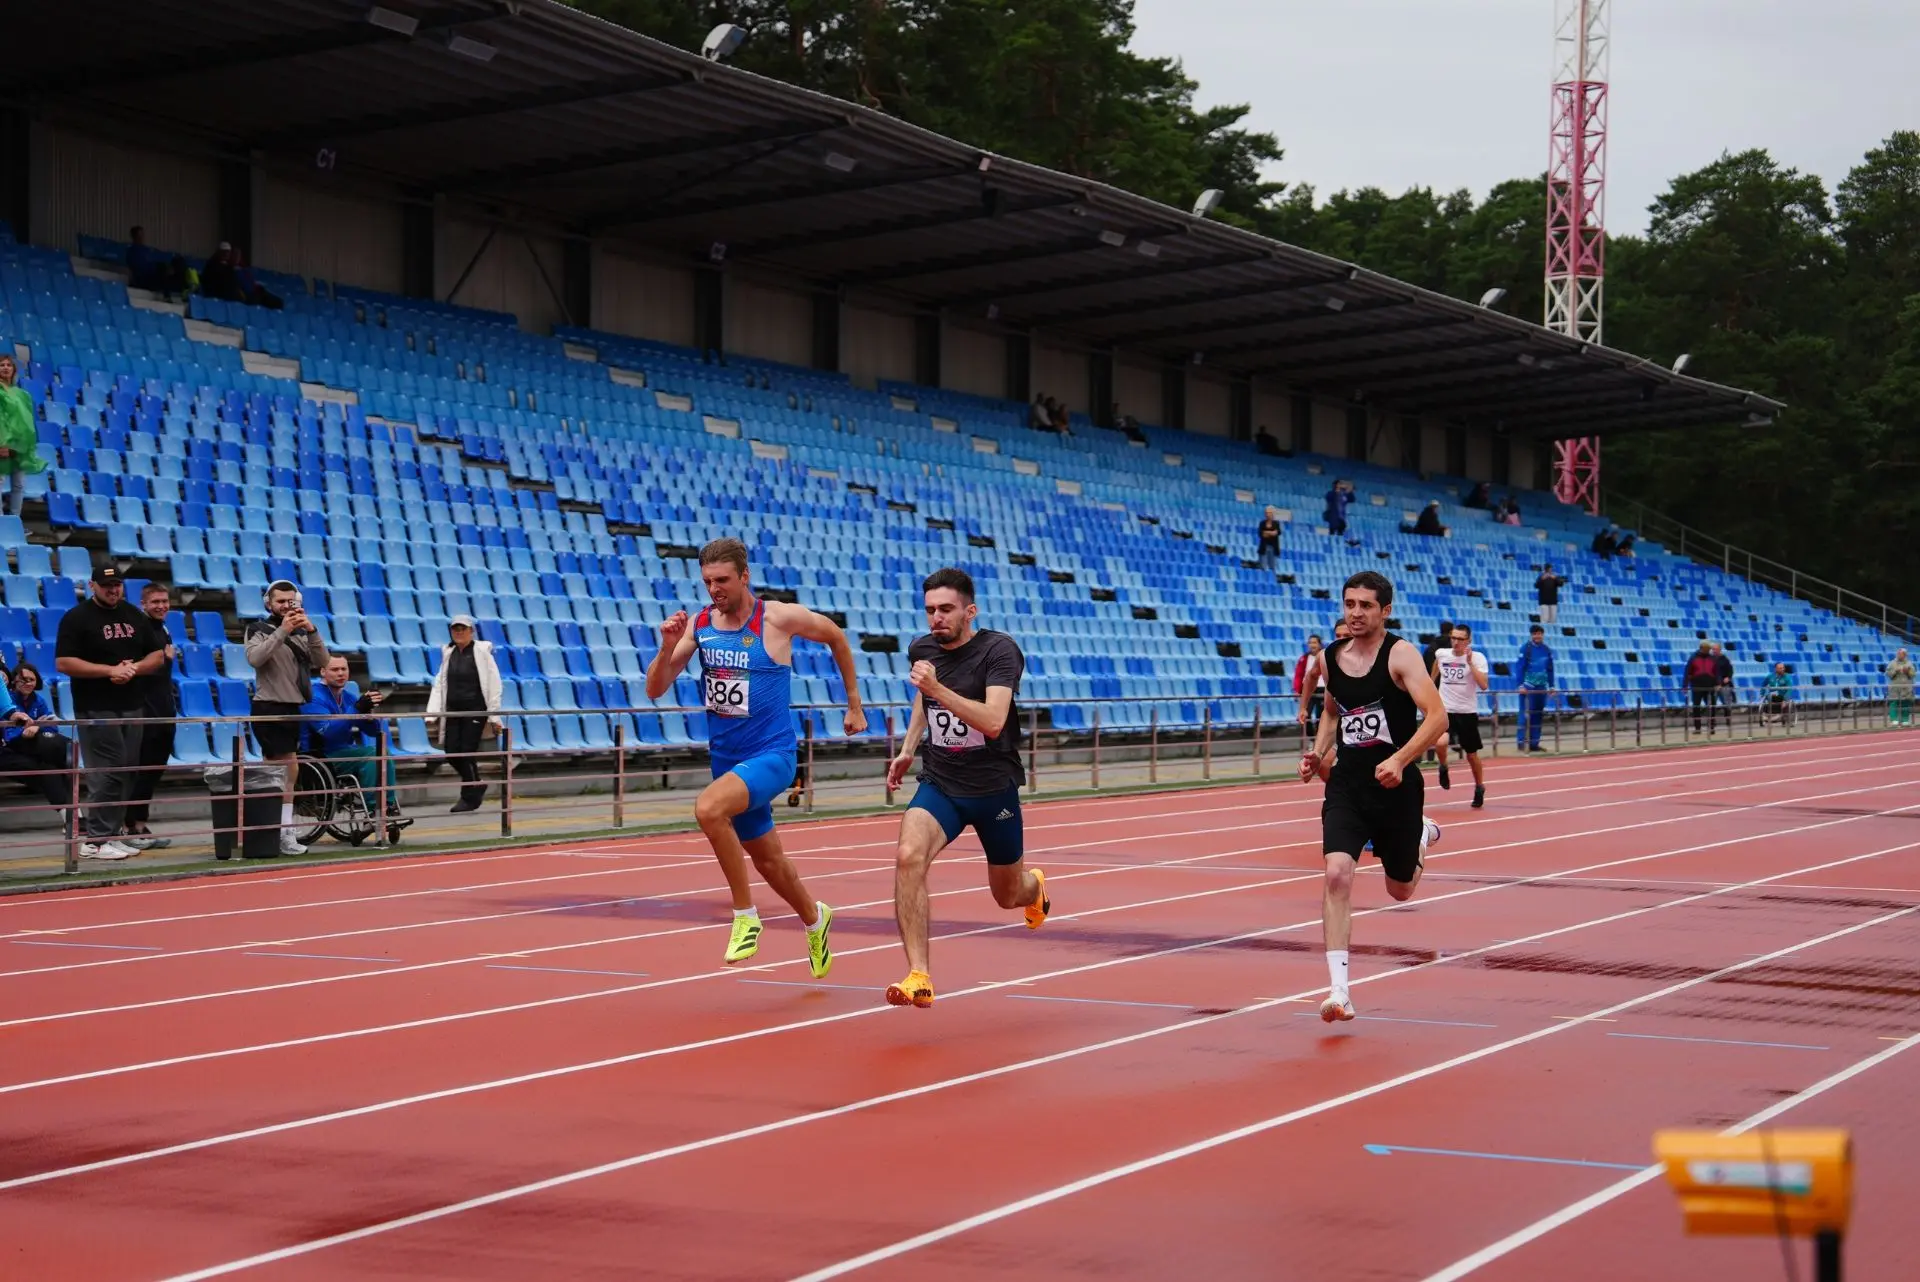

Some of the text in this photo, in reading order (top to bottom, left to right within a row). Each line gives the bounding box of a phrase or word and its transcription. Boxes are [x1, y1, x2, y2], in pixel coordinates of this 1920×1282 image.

[103, 623, 135, 640] GAP
[1443, 668, 1464, 679] 398
[706, 678, 743, 706] 386
[936, 712, 968, 737] 93
